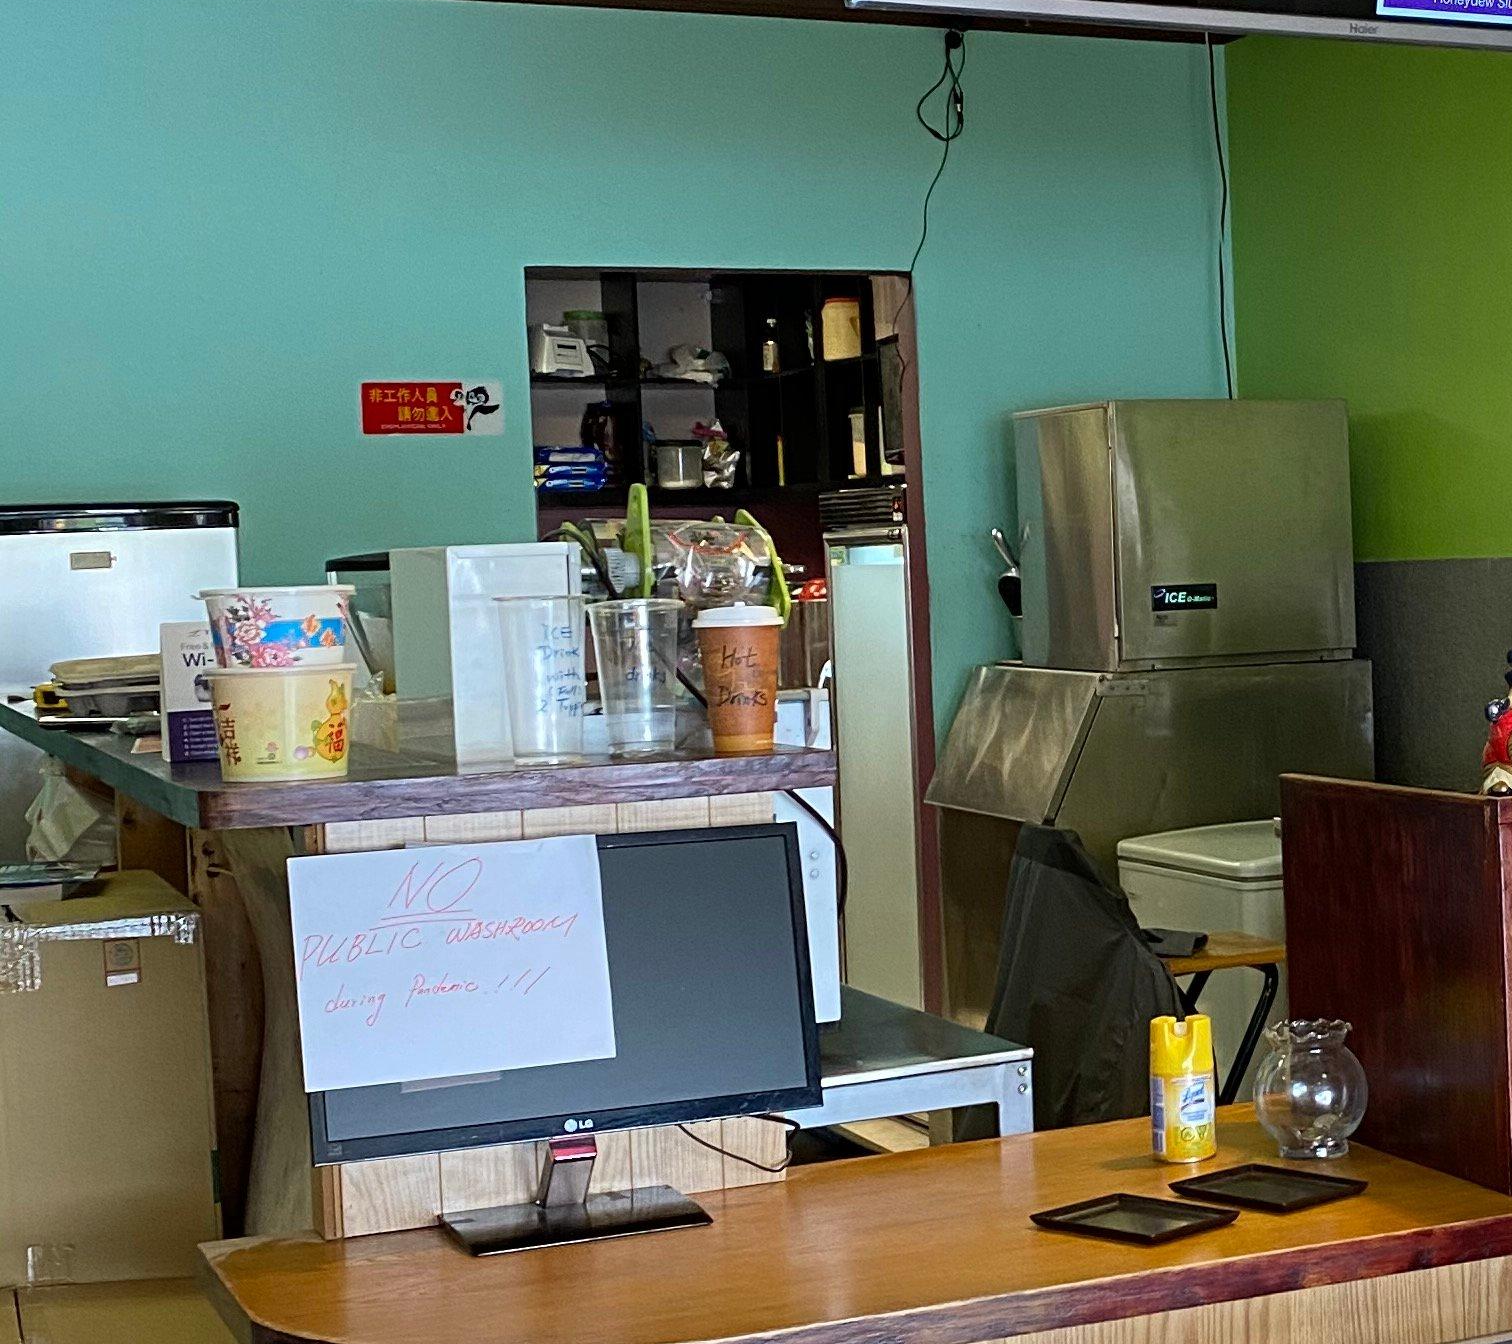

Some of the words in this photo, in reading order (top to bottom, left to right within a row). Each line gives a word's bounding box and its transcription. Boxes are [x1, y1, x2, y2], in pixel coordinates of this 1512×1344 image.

[1350, 23, 1378, 35] Haier
[1165, 592, 1187, 603] ICE
[387, 857, 483, 913] NO
[300, 928, 421, 981] PUBLIC
[324, 985, 385, 1026] during
[579, 1118, 593, 1129] LG
